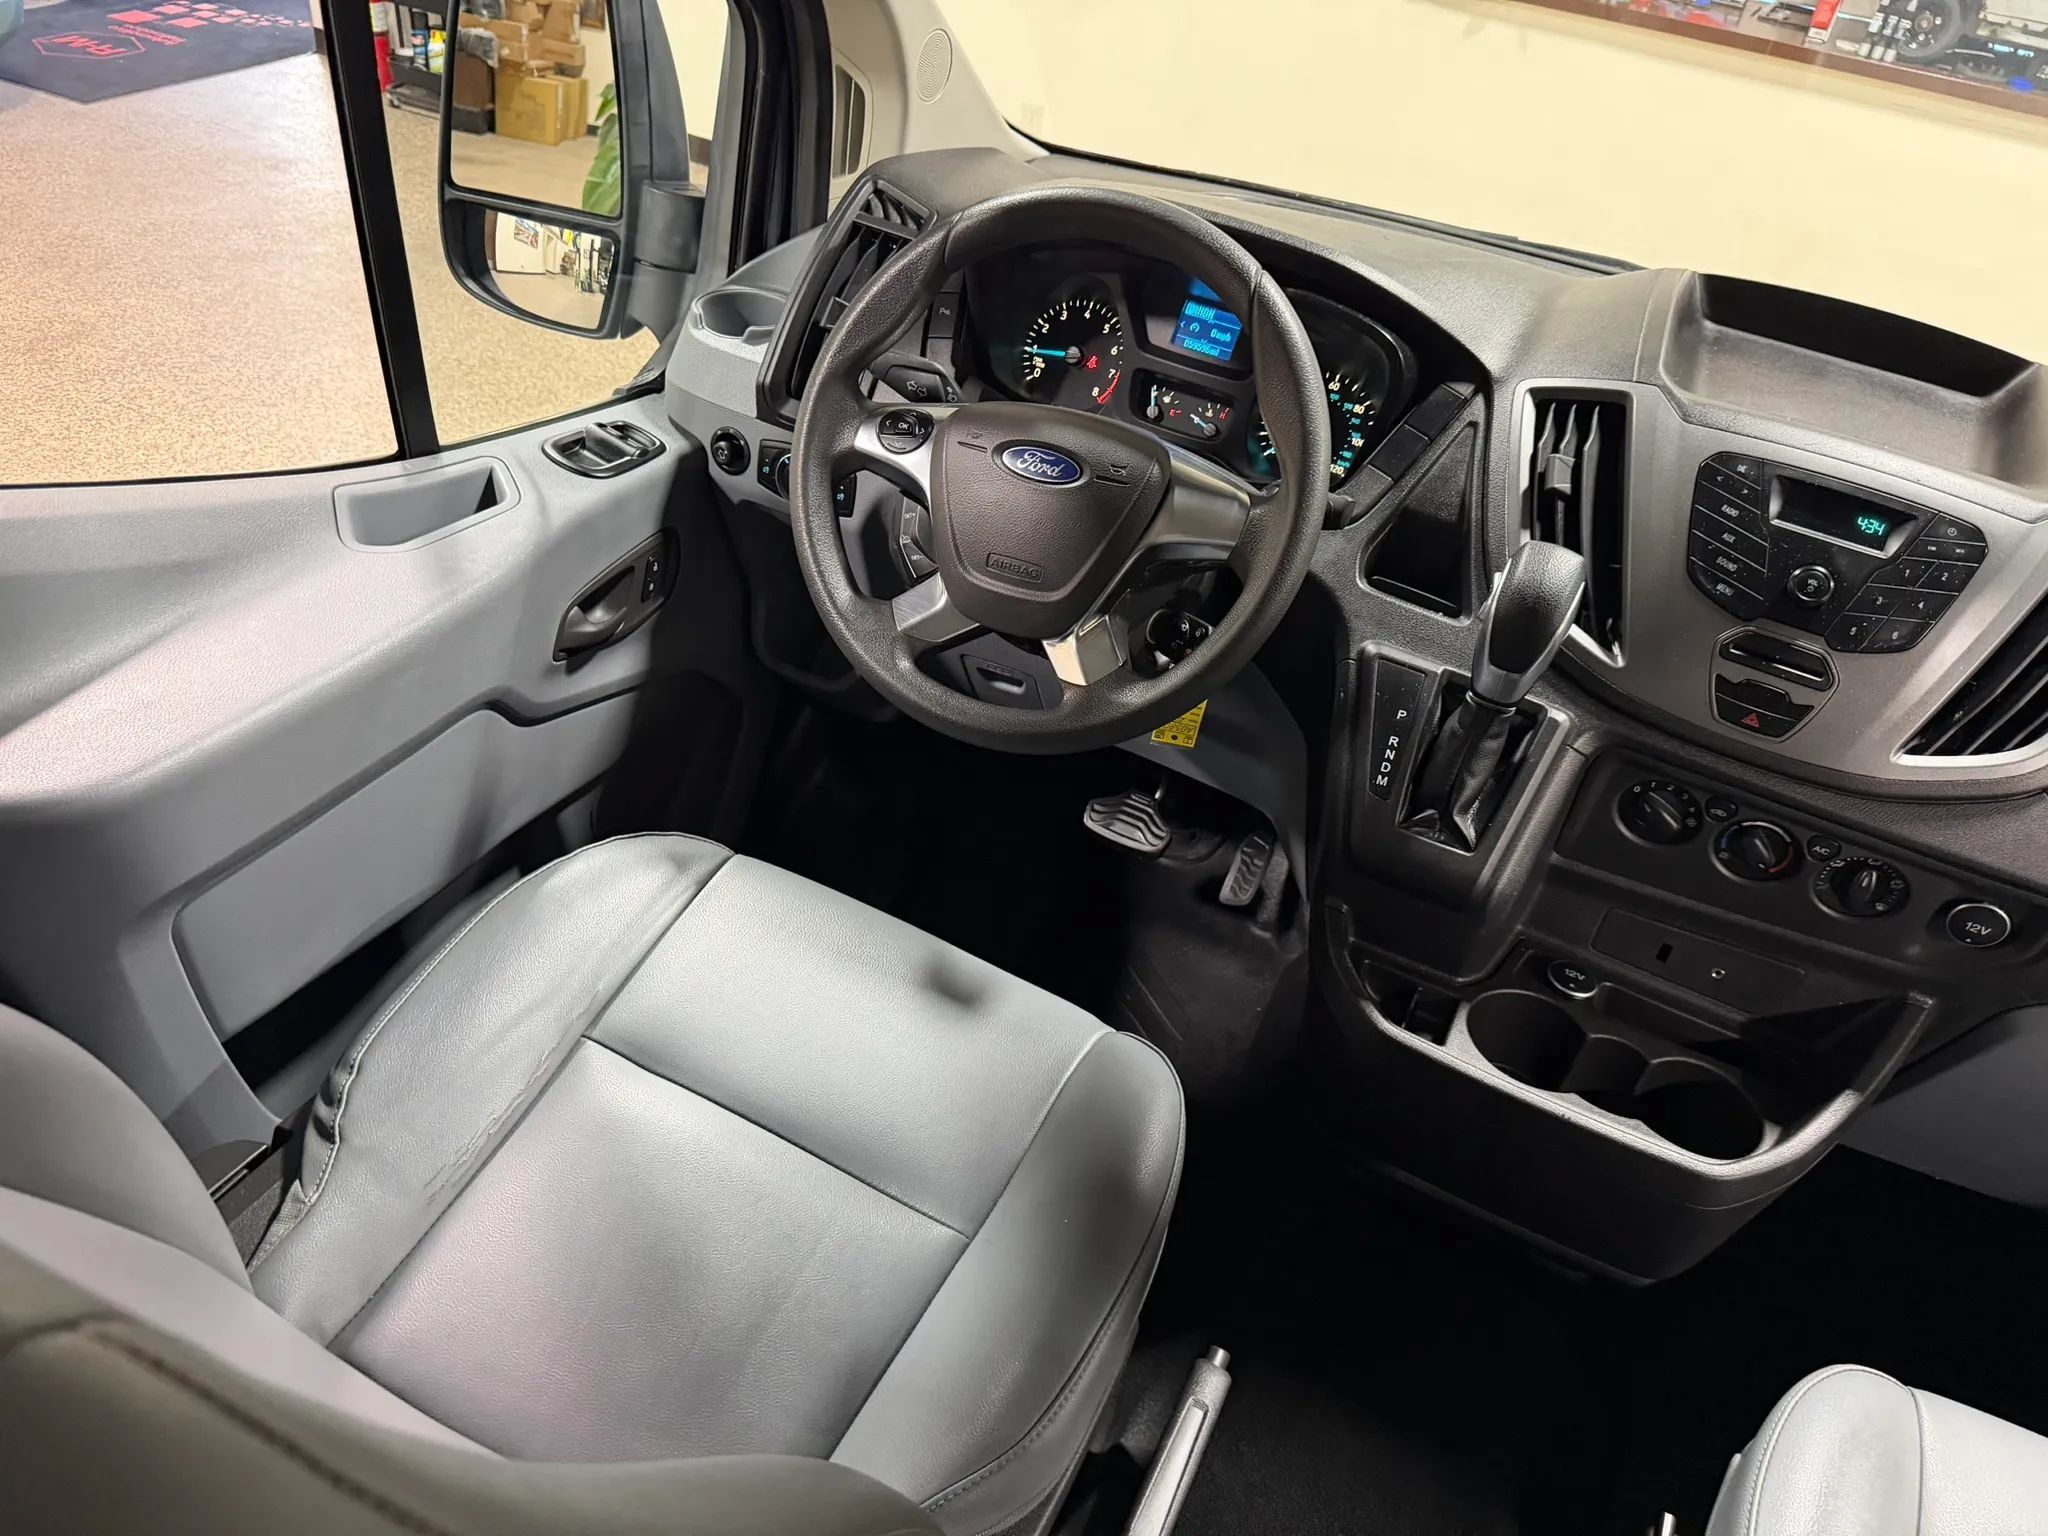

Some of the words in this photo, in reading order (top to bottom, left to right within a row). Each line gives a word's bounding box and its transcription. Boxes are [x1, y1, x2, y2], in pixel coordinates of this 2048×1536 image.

[1060, 311, 1068, 320] 3
[1084, 309, 1091, 319] 4
[1042, 324, 1050, 333] 2
[1102, 324, 1111, 333] 5
[1110, 345, 1118, 356] 6
[1033, 367, 1041, 378] 0
[1108, 368, 1116, 379] 7
[1328, 382, 1340, 390] 60
[1091, 386, 1100, 397] 8
[1353, 404, 1364, 414] 80
[898, 422, 910, 430] OK
[1016, 449, 1063, 477] Ford
[1330, 464, 1344, 474] 120
[1720, 504, 1739, 518] RADIO
[1857, 515, 1885, 536] 434
[1720, 532, 1737, 544] AUX
[990, 557, 1040, 578] AIRBAG
[1715, 556, 1739, 572] SOUND
[1940, 572, 1950, 582] 2
[1715, 582, 1735, 597] MENU
[1875, 596, 1883, 605] 3
[1917, 601, 1925, 610] 4
[1849, 627, 1858, 636] 5
[1891, 631, 1900, 641] 6
[1397, 710, 1407, 719] P
[1388, 736, 1399, 747] R
[1384, 749, 1395, 760] N
[1380, 762, 1391, 772] D
[1376, 775, 1388, 786] M
[1632, 785, 1642, 793] 0
[1666, 784, 1676, 792] 2
[1965, 921, 1993, 937] 12V
[1564, 968, 1586, 980] 12V
